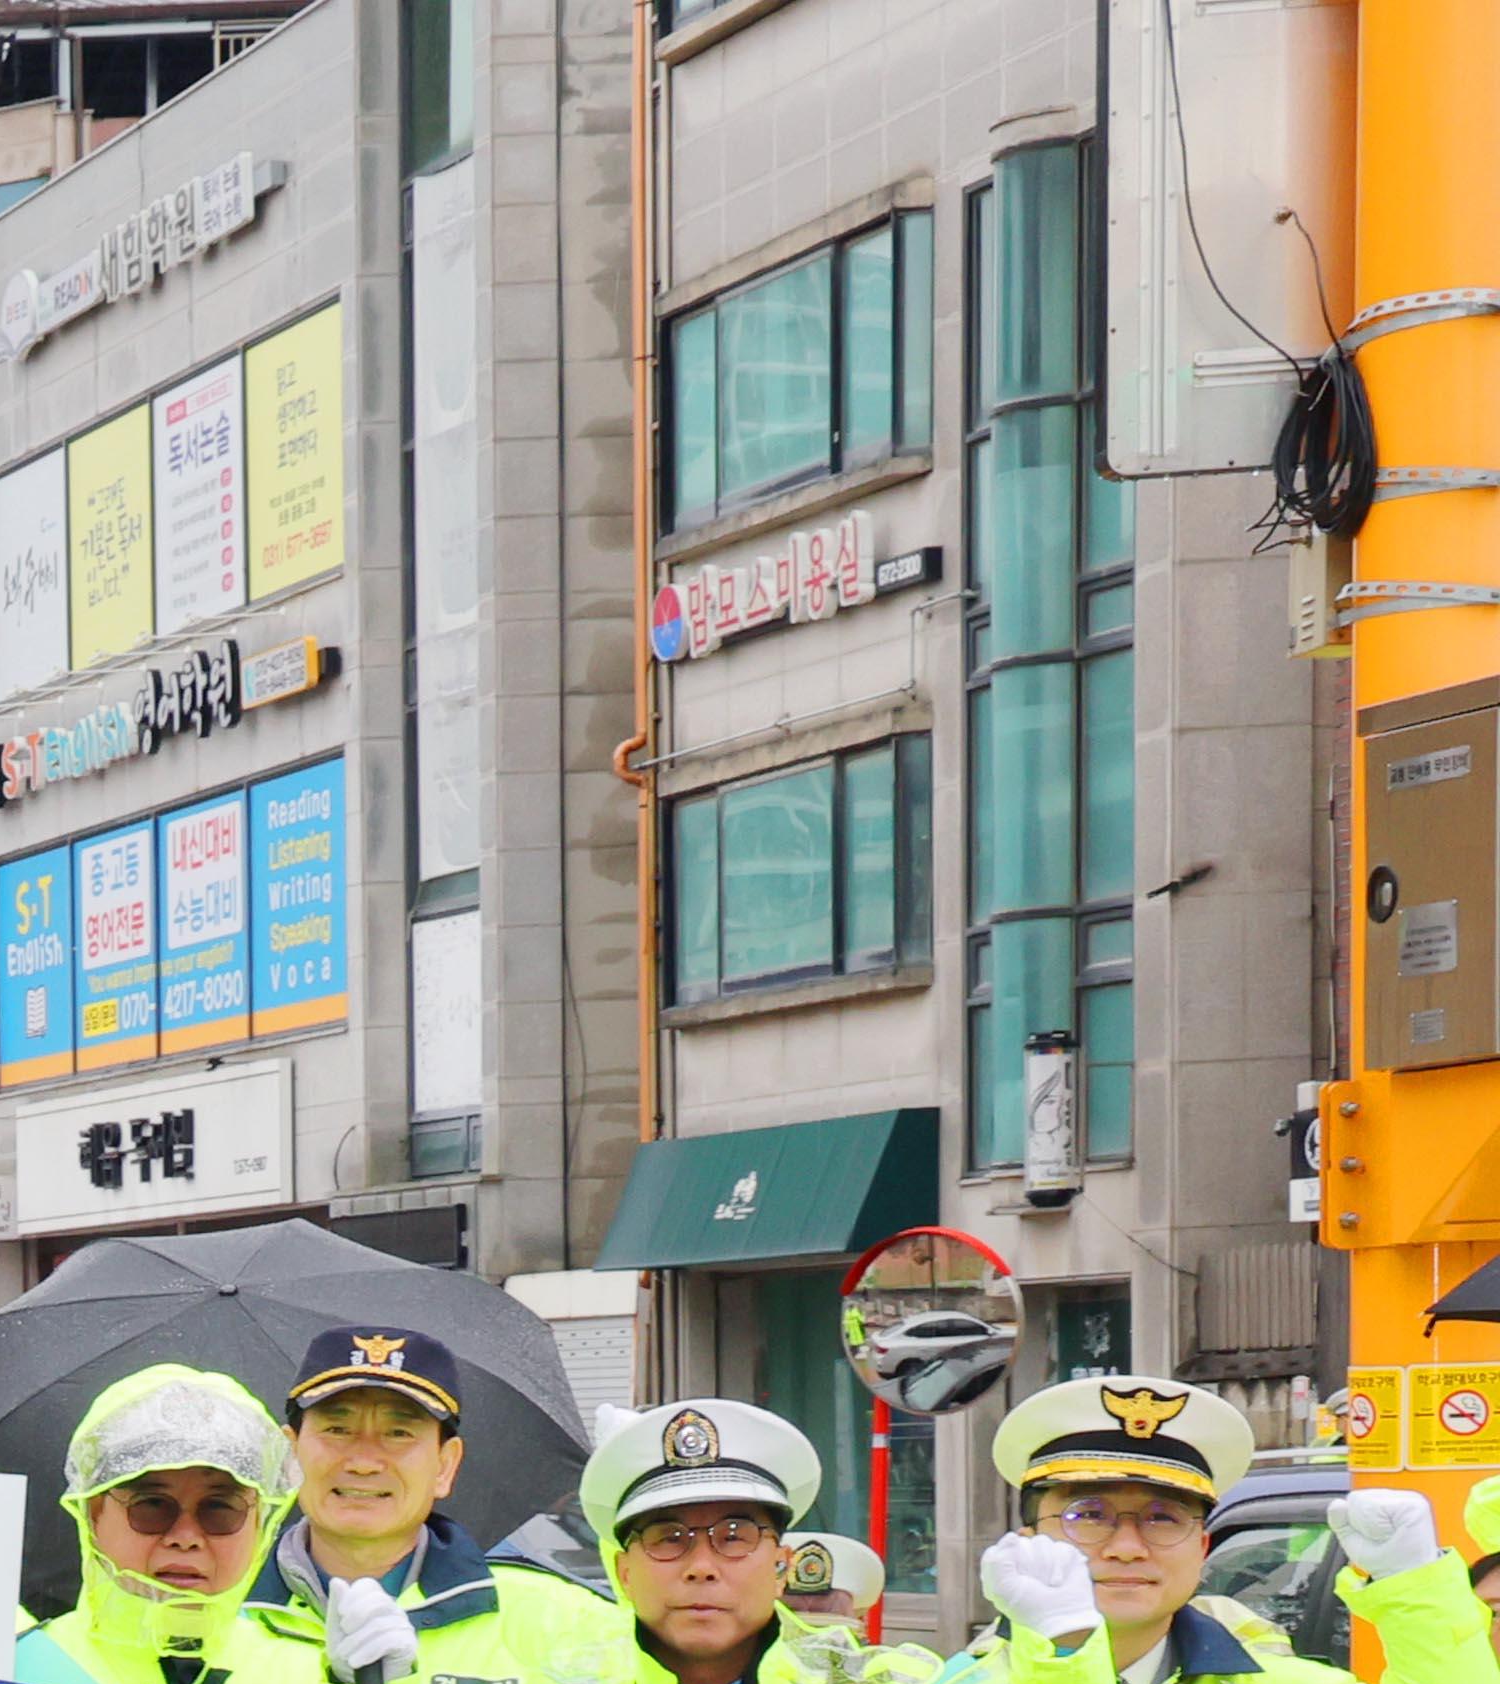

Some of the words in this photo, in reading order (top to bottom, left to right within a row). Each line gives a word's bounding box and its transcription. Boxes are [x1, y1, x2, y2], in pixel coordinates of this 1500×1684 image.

[687, 515, 860, 649] 맘모스미용실
[134, 638, 233, 754] 영어학원
[268, 789, 332, 830] Reading
[172, 810, 238, 871] 내신대비
[268, 829, 332, 871] Listening
[172, 875, 238, 937] 수능대비
[268, 872, 333, 912] Writing
[7, 932, 64, 977] English
[86, 900, 146, 959] 영어전문
[270, 913, 332, 954] Speaking
